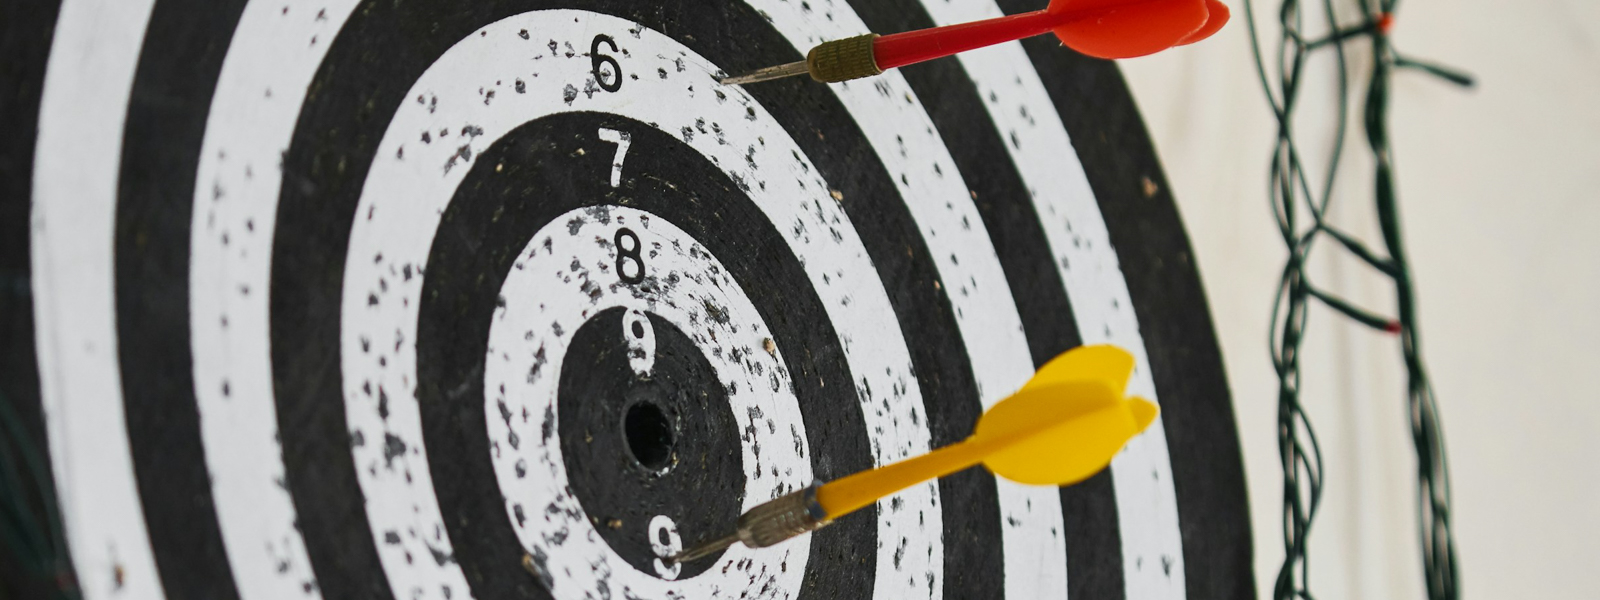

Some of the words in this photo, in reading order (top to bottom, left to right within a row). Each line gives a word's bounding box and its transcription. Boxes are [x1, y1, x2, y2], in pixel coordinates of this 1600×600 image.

[591, 33, 622, 92] 6
[598, 127, 632, 187] 7
[614, 227, 645, 284] 8
[622, 308, 656, 377] 9
[648, 514, 683, 580] 9
